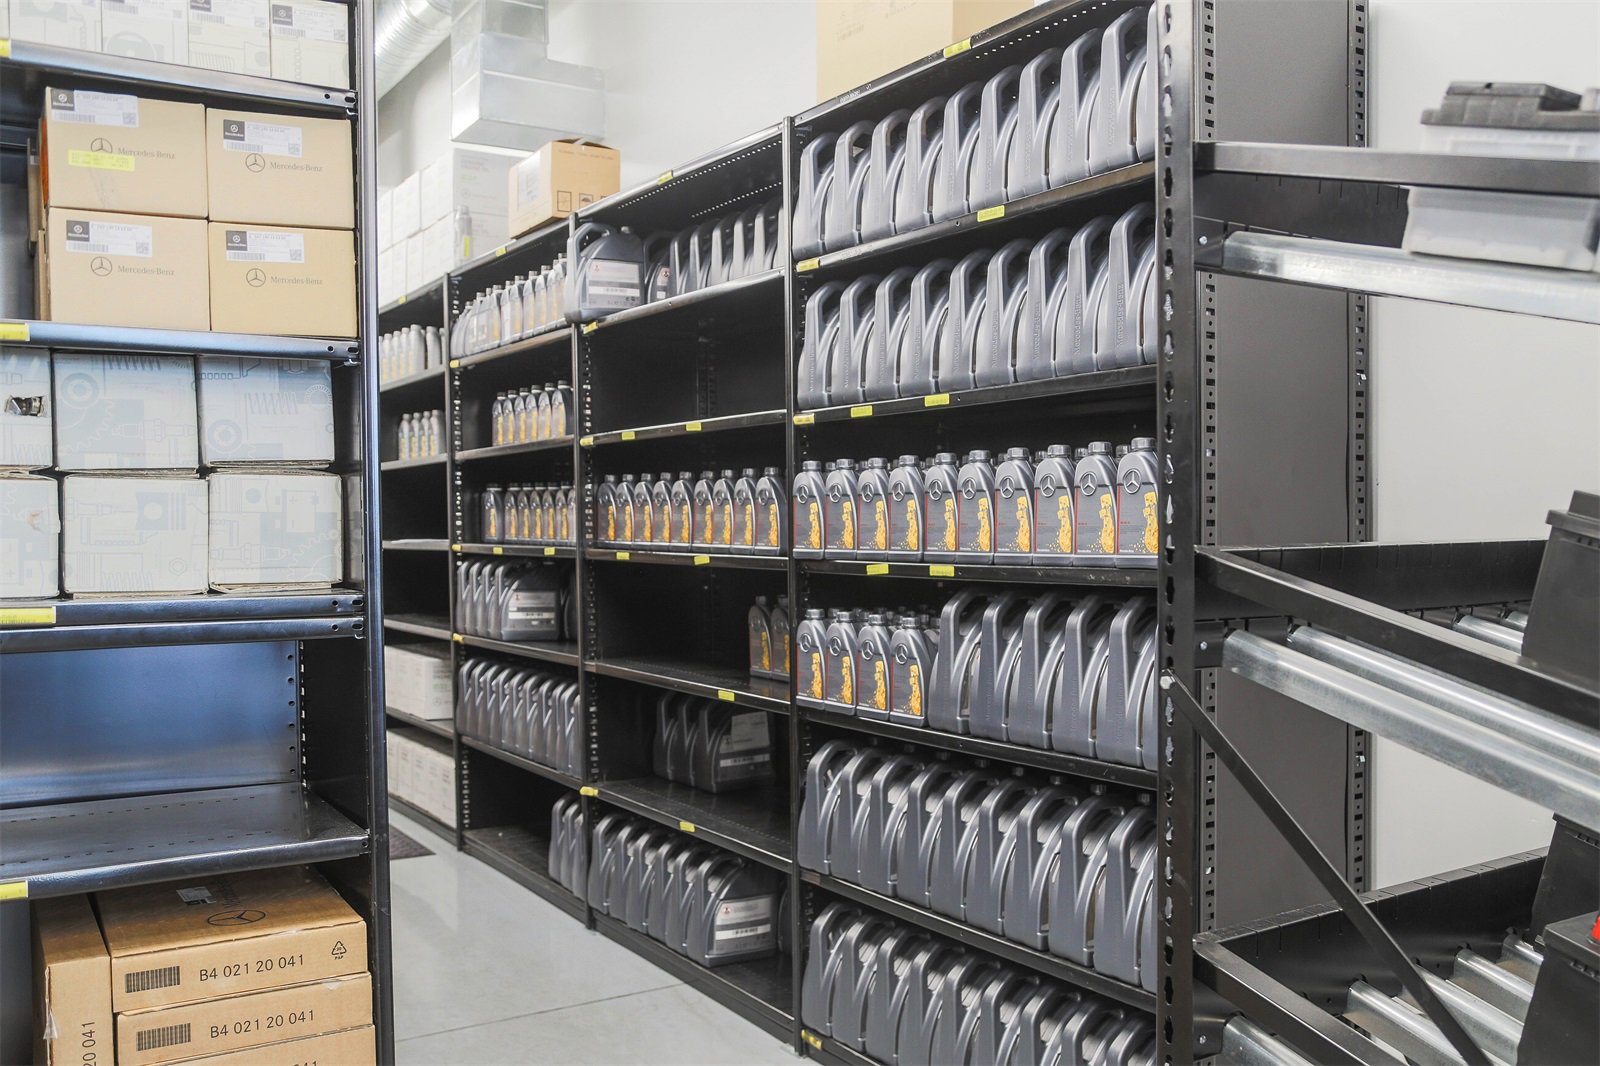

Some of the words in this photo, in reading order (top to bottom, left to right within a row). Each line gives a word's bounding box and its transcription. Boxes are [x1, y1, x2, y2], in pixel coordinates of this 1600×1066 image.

[117, 146, 176, 160] Mercedes-Benz
[269, 160, 323, 173] Mercedes-Benz
[117, 264, 175, 277] Mercedes-Benz
[269, 275, 323, 286] Mercedes-Benz
[199, 967, 218, 982] B4
[223, 962, 249, 978] 021
[256, 959, 274, 973] 20
[278, 954, 303, 969] 041
[210, 1024, 229, 1039] B4
[233, 1018, 260, 1034] 021
[266, 1014, 284, 1029] 20
[288, 1009, 314, 1024] 041
[81, 1021, 96, 1048] 041
